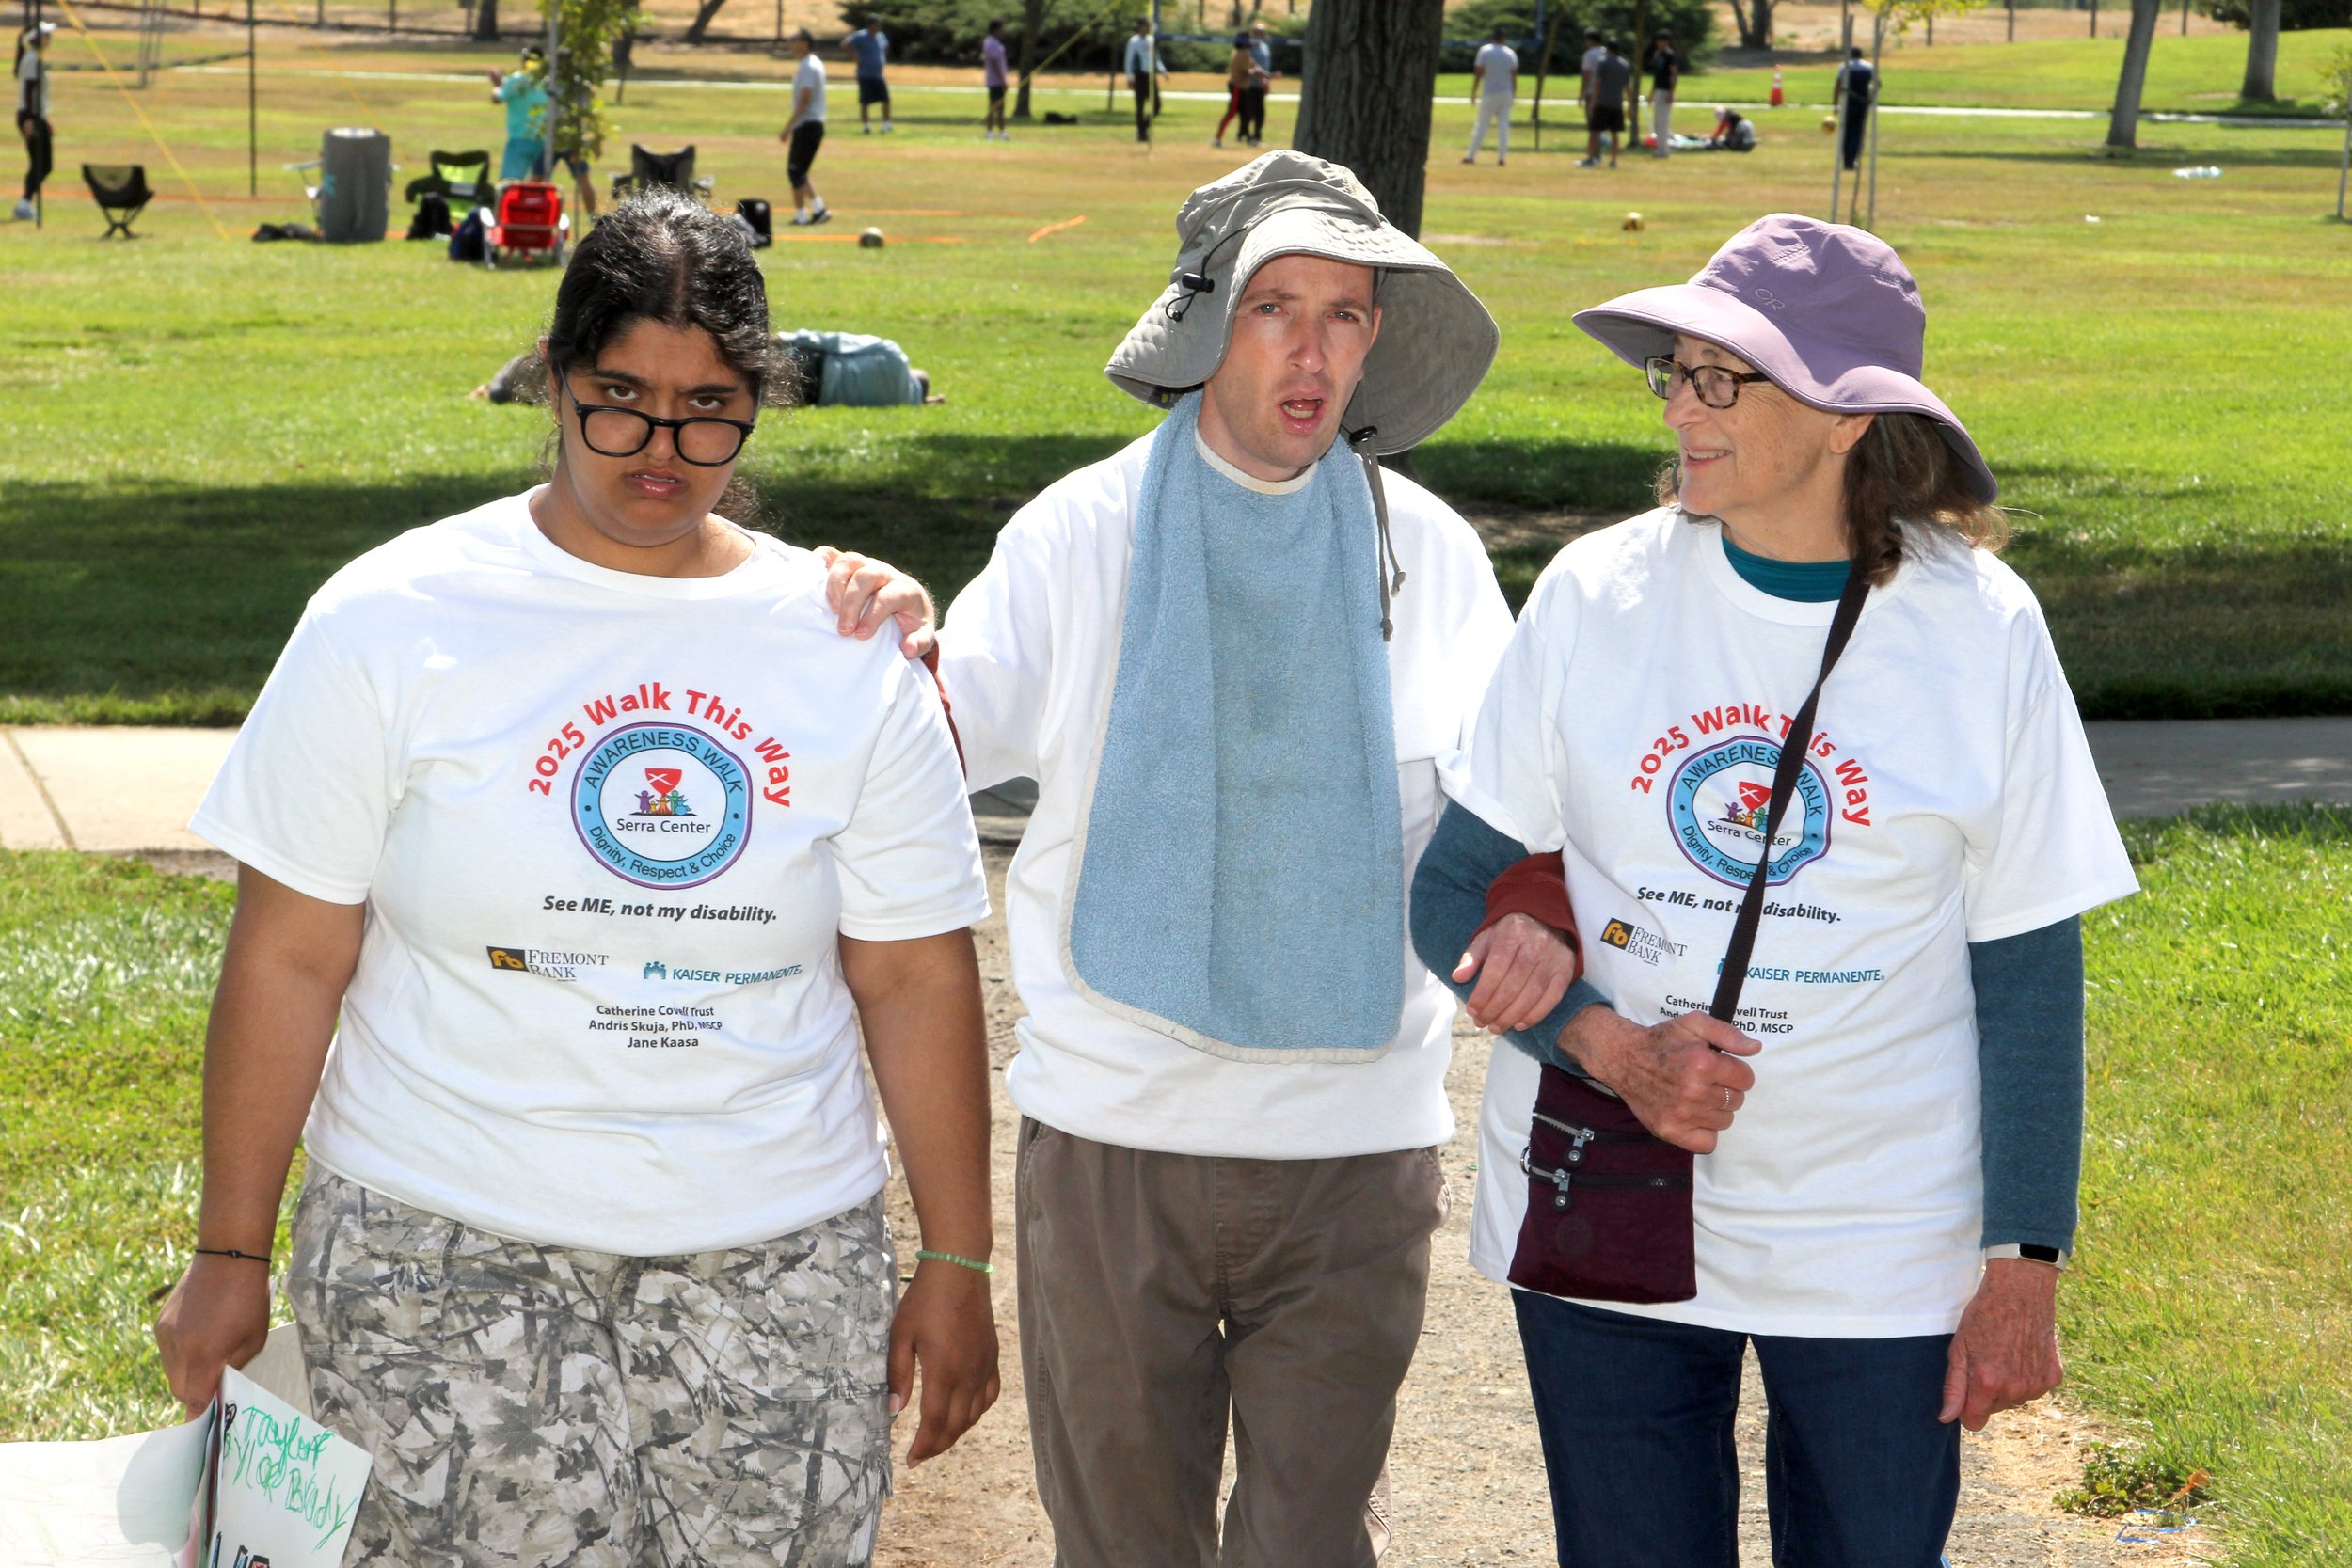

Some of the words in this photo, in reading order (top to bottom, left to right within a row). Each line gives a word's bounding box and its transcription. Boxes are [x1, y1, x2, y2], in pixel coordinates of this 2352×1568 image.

[529, 721, 585, 796] 2025
[583, 682, 671, 727] Walk
[686, 689, 753, 741] This
[754, 736, 790, 808] Way
[584, 731, 700, 789] AWARENESS
[703, 747, 743, 794] WALK
[1631, 725, 1690, 793] 2025
[1691, 703, 1771, 735] Walk
[1780, 714, 1836, 757] Tis
[1835, 758, 1870, 826] Way
[1682, 744, 1780, 790] AWARENES
[616, 818, 655, 832] Serra
[660, 820, 711, 833] Center
[1708, 820, 1740, 838] Serra
[589, 826, 626, 867] Dignity,
[629, 859, 687, 880] Respect
[689, 862, 700, 874] &
[700, 833, 736, 868] Choice
[1682, 825, 1714, 864] Dignity,
[1716, 858, 1755, 880] Respe
[1768, 865, 1777, 877] &
[1778, 847, 1813, 874] Choice
[543, 895, 578, 911] See
[581, 897, 615, 916] ME,
[621, 903, 653, 917] not
[658, 906, 686, 922] my
[690, 904, 777, 924] disability.
[1637, 886, 1665, 901] See
[1668, 891, 1699, 908] ME,
[1703, 898, 1733, 913] not
[1762, 902, 1841, 924] disability.
[528, 949, 609, 966] FREMONT
[1628, 939, 1661, 963] BANK
[530, 964, 577, 979] BANK
[673, 968, 721, 982] KAISER
[1746, 967, 1789, 981] KAISER
[596, 1005, 655, 1016] Catherine
[659, 1006, 688, 1017] Covell
[691, 1006, 714, 1017] Trust
[1665, 995, 1712, 1012] Catherin
[1736, 1007, 1756, 1018] vell
[1759, 1008, 1788, 1019] Trust
[589, 1020, 628, 1031] Andris
[631, 1021, 668, 1034] Skuja,
[672, 1021, 697, 1031] PhD,
[698, 1021, 723, 1031] MSCP
[1761, 1023, 1793, 1034] MSCP
[628, 1037, 658, 1048] Jane
[660, 1037, 698, 1048] Kaasa
